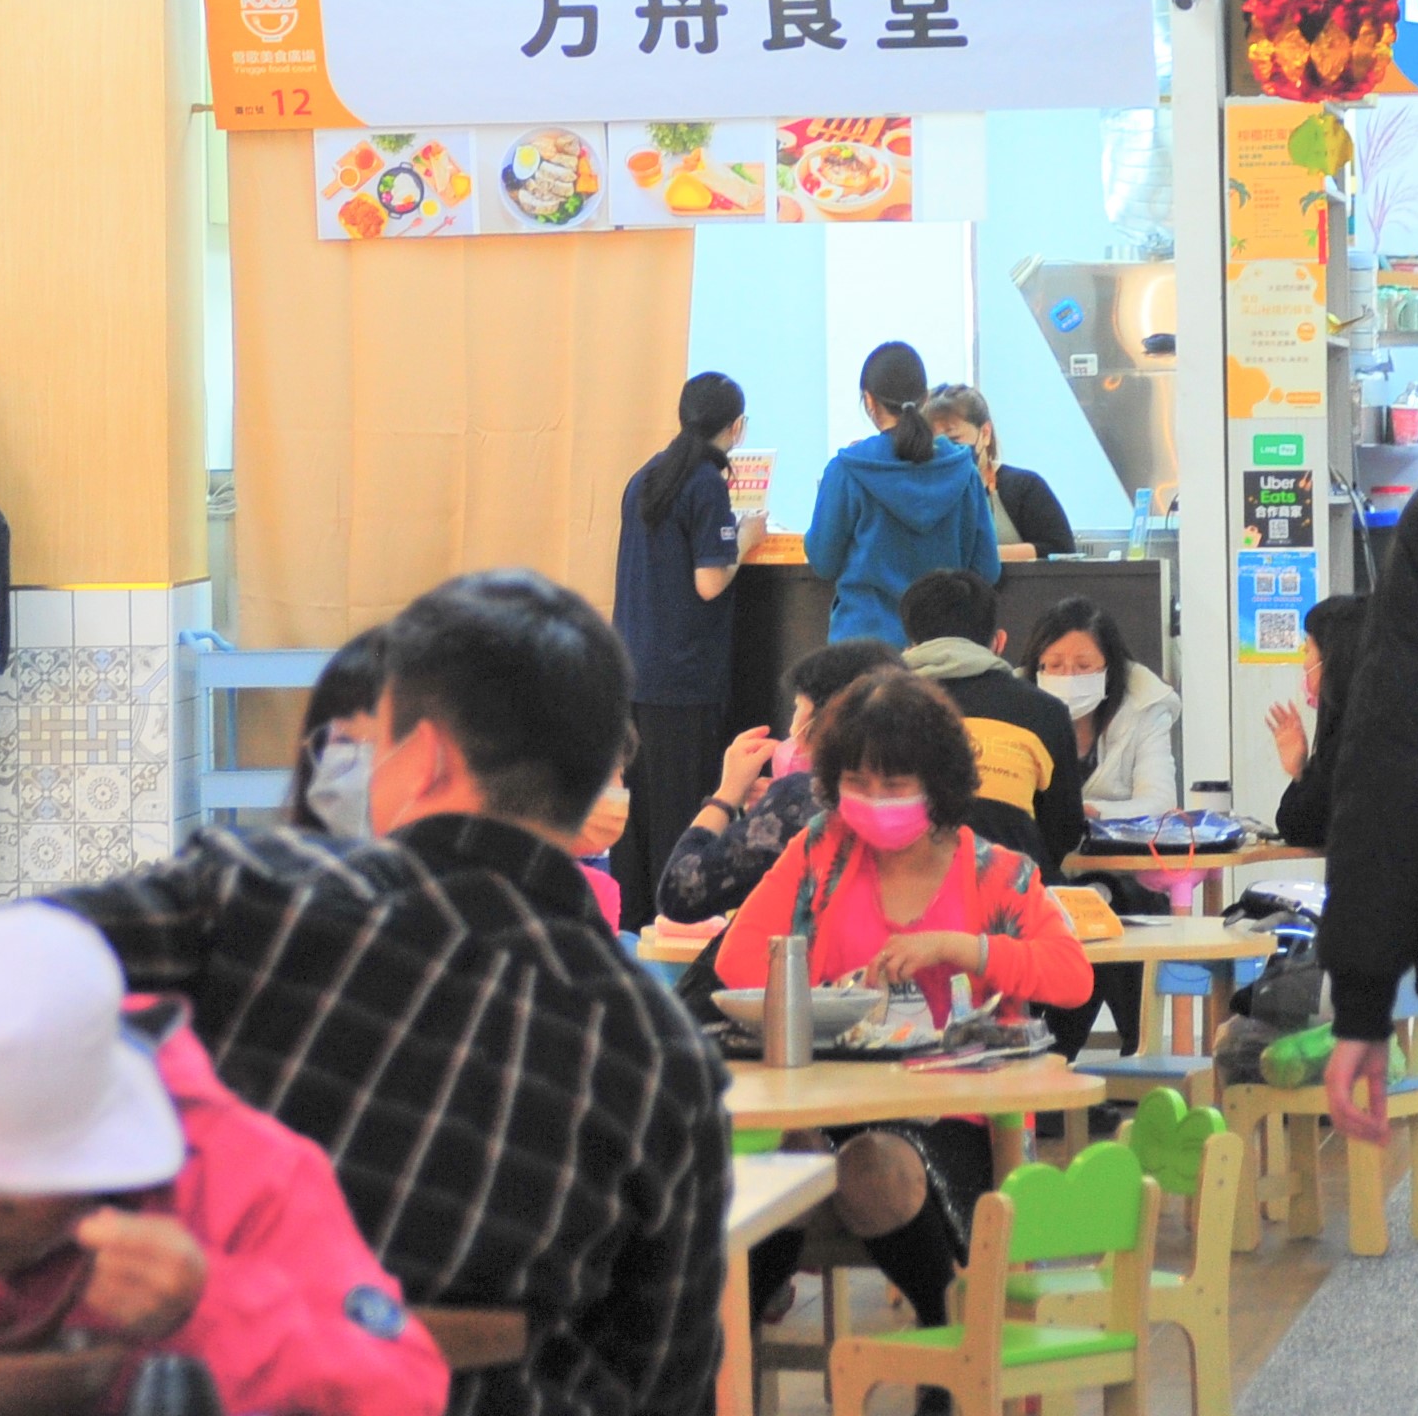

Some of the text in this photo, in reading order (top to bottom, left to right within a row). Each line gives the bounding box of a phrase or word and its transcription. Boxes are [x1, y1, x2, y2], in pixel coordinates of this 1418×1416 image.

[271, 88, 312, 116] 12
[1260, 476, 1296, 490] Uber
[1261, 491, 1296, 504] Eats
